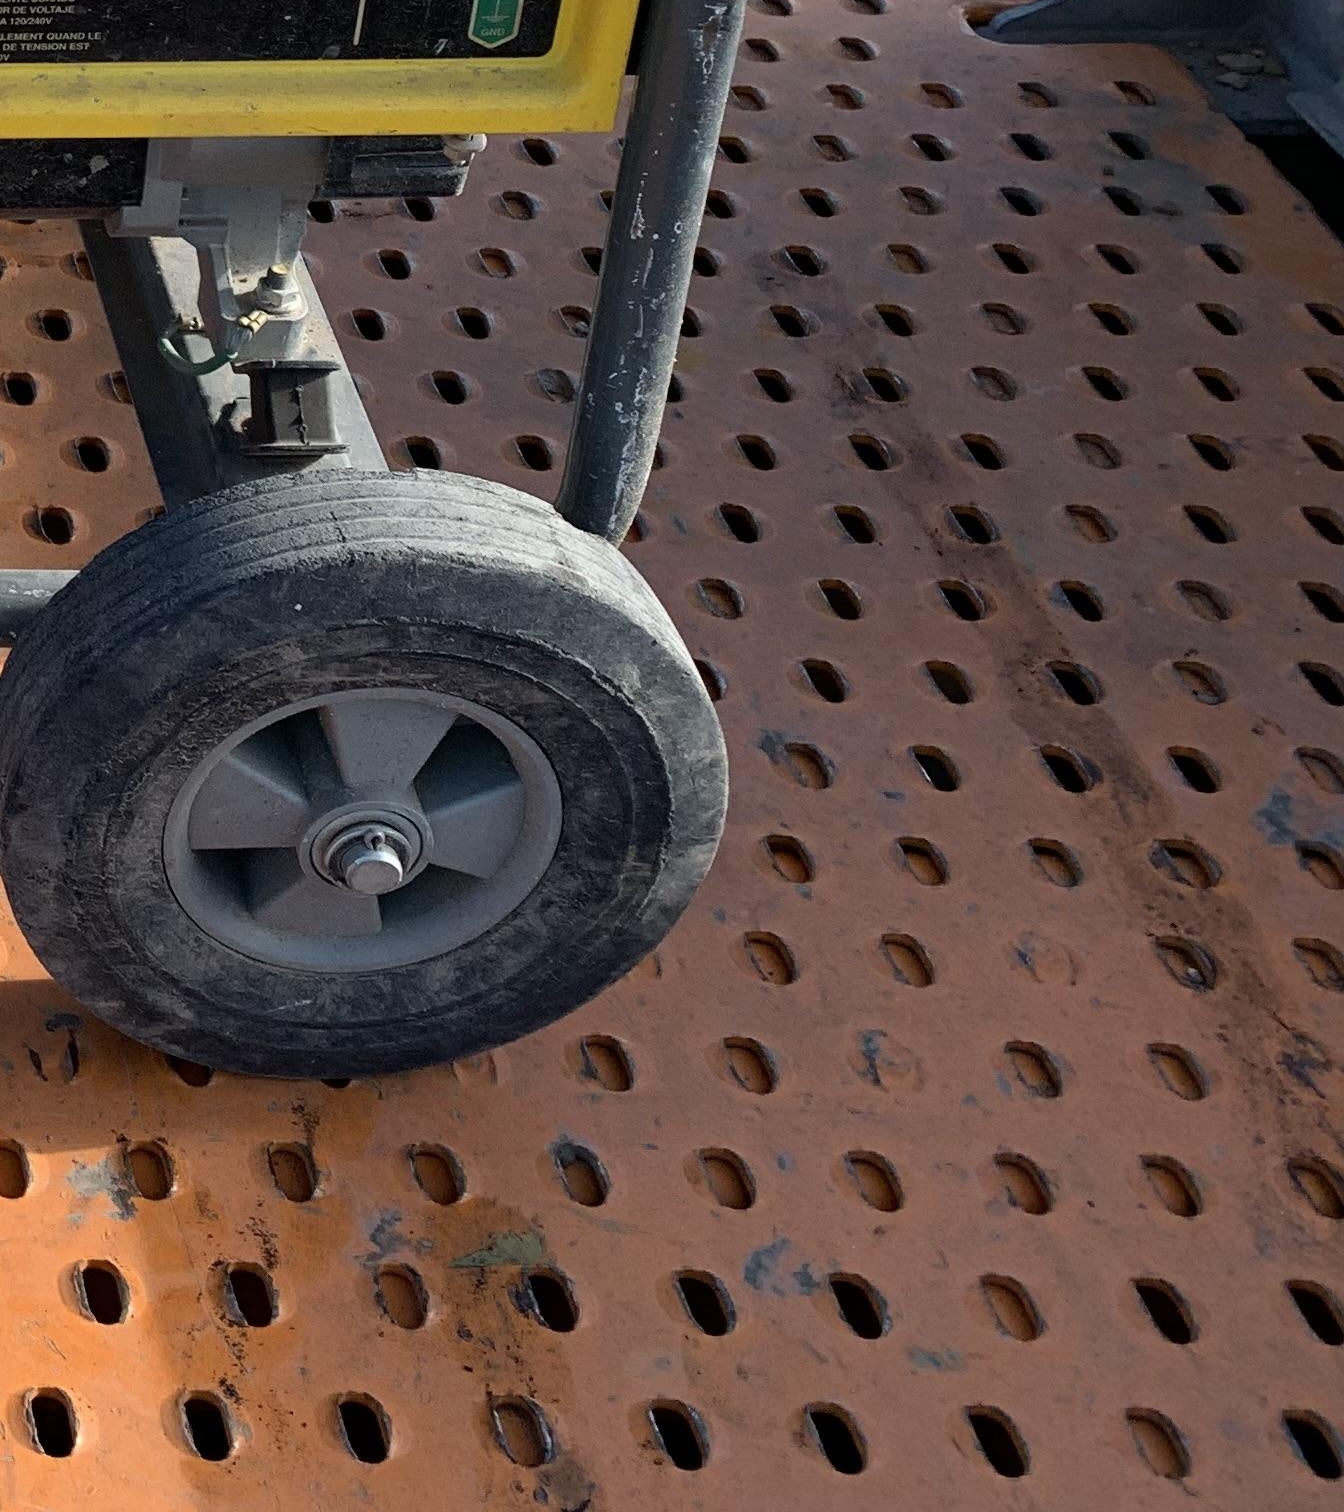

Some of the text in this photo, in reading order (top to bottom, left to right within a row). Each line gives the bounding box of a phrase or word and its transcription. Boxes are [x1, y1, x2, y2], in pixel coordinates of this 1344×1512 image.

[13, 6, 27, 14] DE
[30, 5, 75, 13] VOLTAJE
[11, 17, 53, 25] 120/240V
[46, 32, 85, 40] QUAND
[88, 32, 101, 40] LE
[481, 28, 505, 36] GND
[2, 43, 18, 52] DE
[20, 43, 67, 51] TENSION
[69, 42, 90, 50] EST
